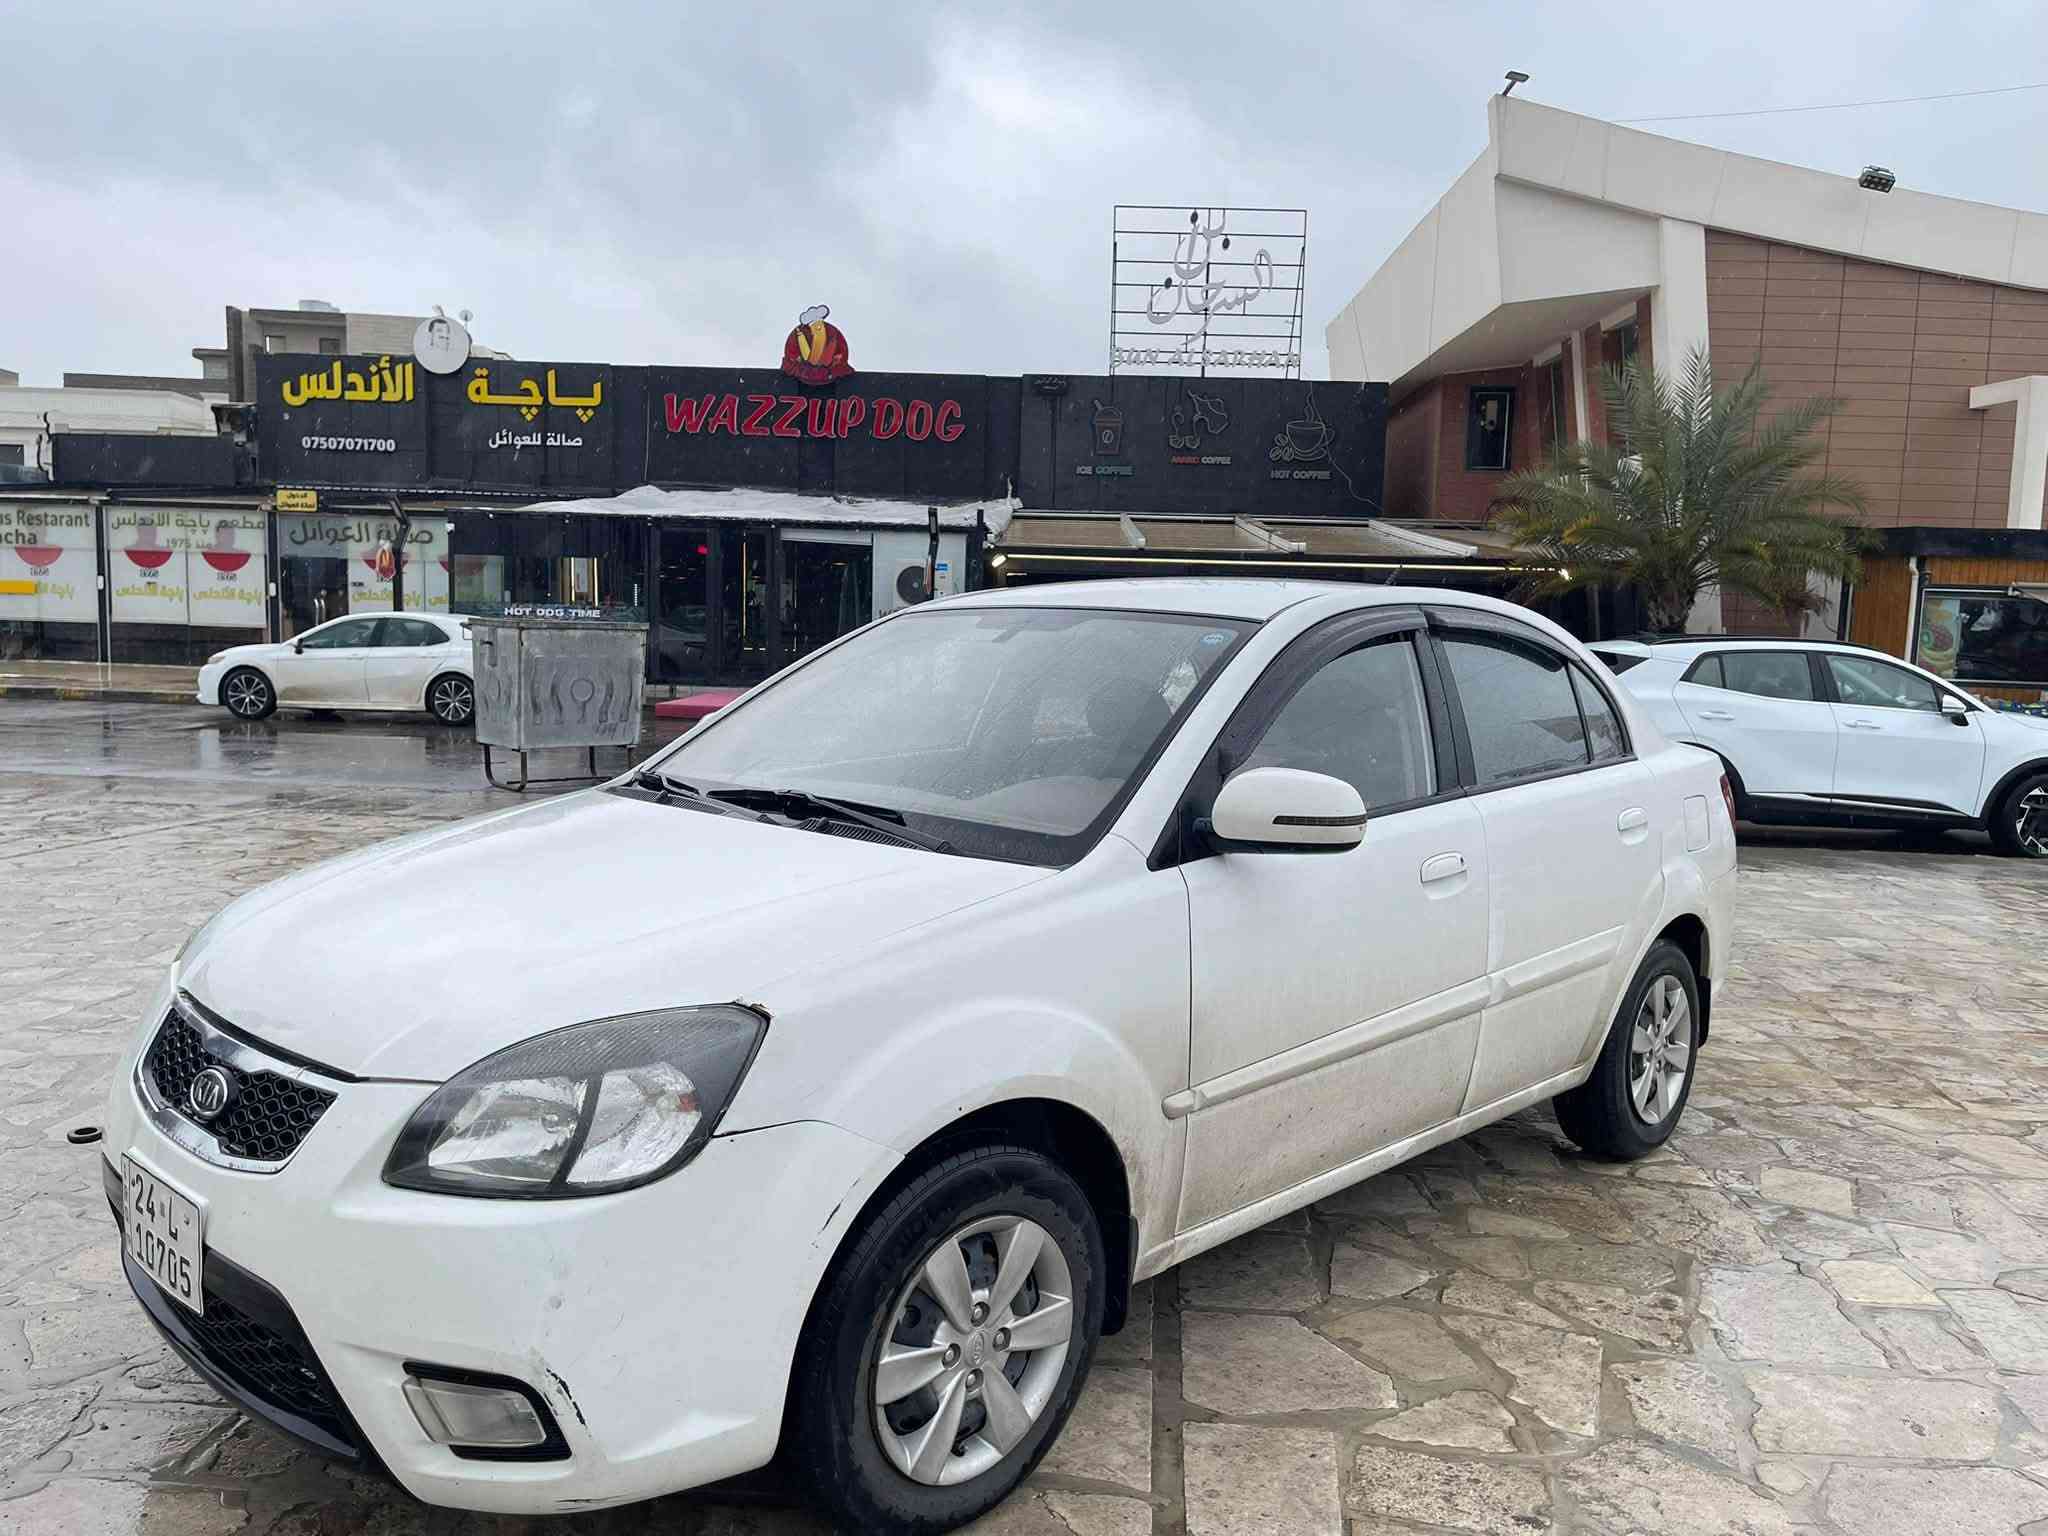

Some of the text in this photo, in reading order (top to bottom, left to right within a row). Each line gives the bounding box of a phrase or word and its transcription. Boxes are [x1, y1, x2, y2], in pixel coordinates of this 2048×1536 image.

[1110, 347, 1160, 368] BUN
[282, 354, 602, 424] پاچة الأندلس
[663, 393, 967, 442] WAZZUP DOG
[302, 436, 396, 451] 07507071700
[488, 429, 583, 449] صالة للعوائل
[1076, 465, 1133, 475] ICE COFFEE
[1201, 456, 1232, 465] COFFEE
[1271, 470, 1331, 480] HOT COFFEE
[16, 509, 90, 527] Restarant
[216, 515, 266, 534] مطعم
[0, 529, 38, 545] cha
[504, 607, 532, 616] HOT
[569, 608, 601, 618] TIME
[196, 1075, 220, 1111] KIA
[134, 1173, 156, 1225] 24
[168, 1195, 179, 1241] L
[135, 1222, 192, 1298] 10705
